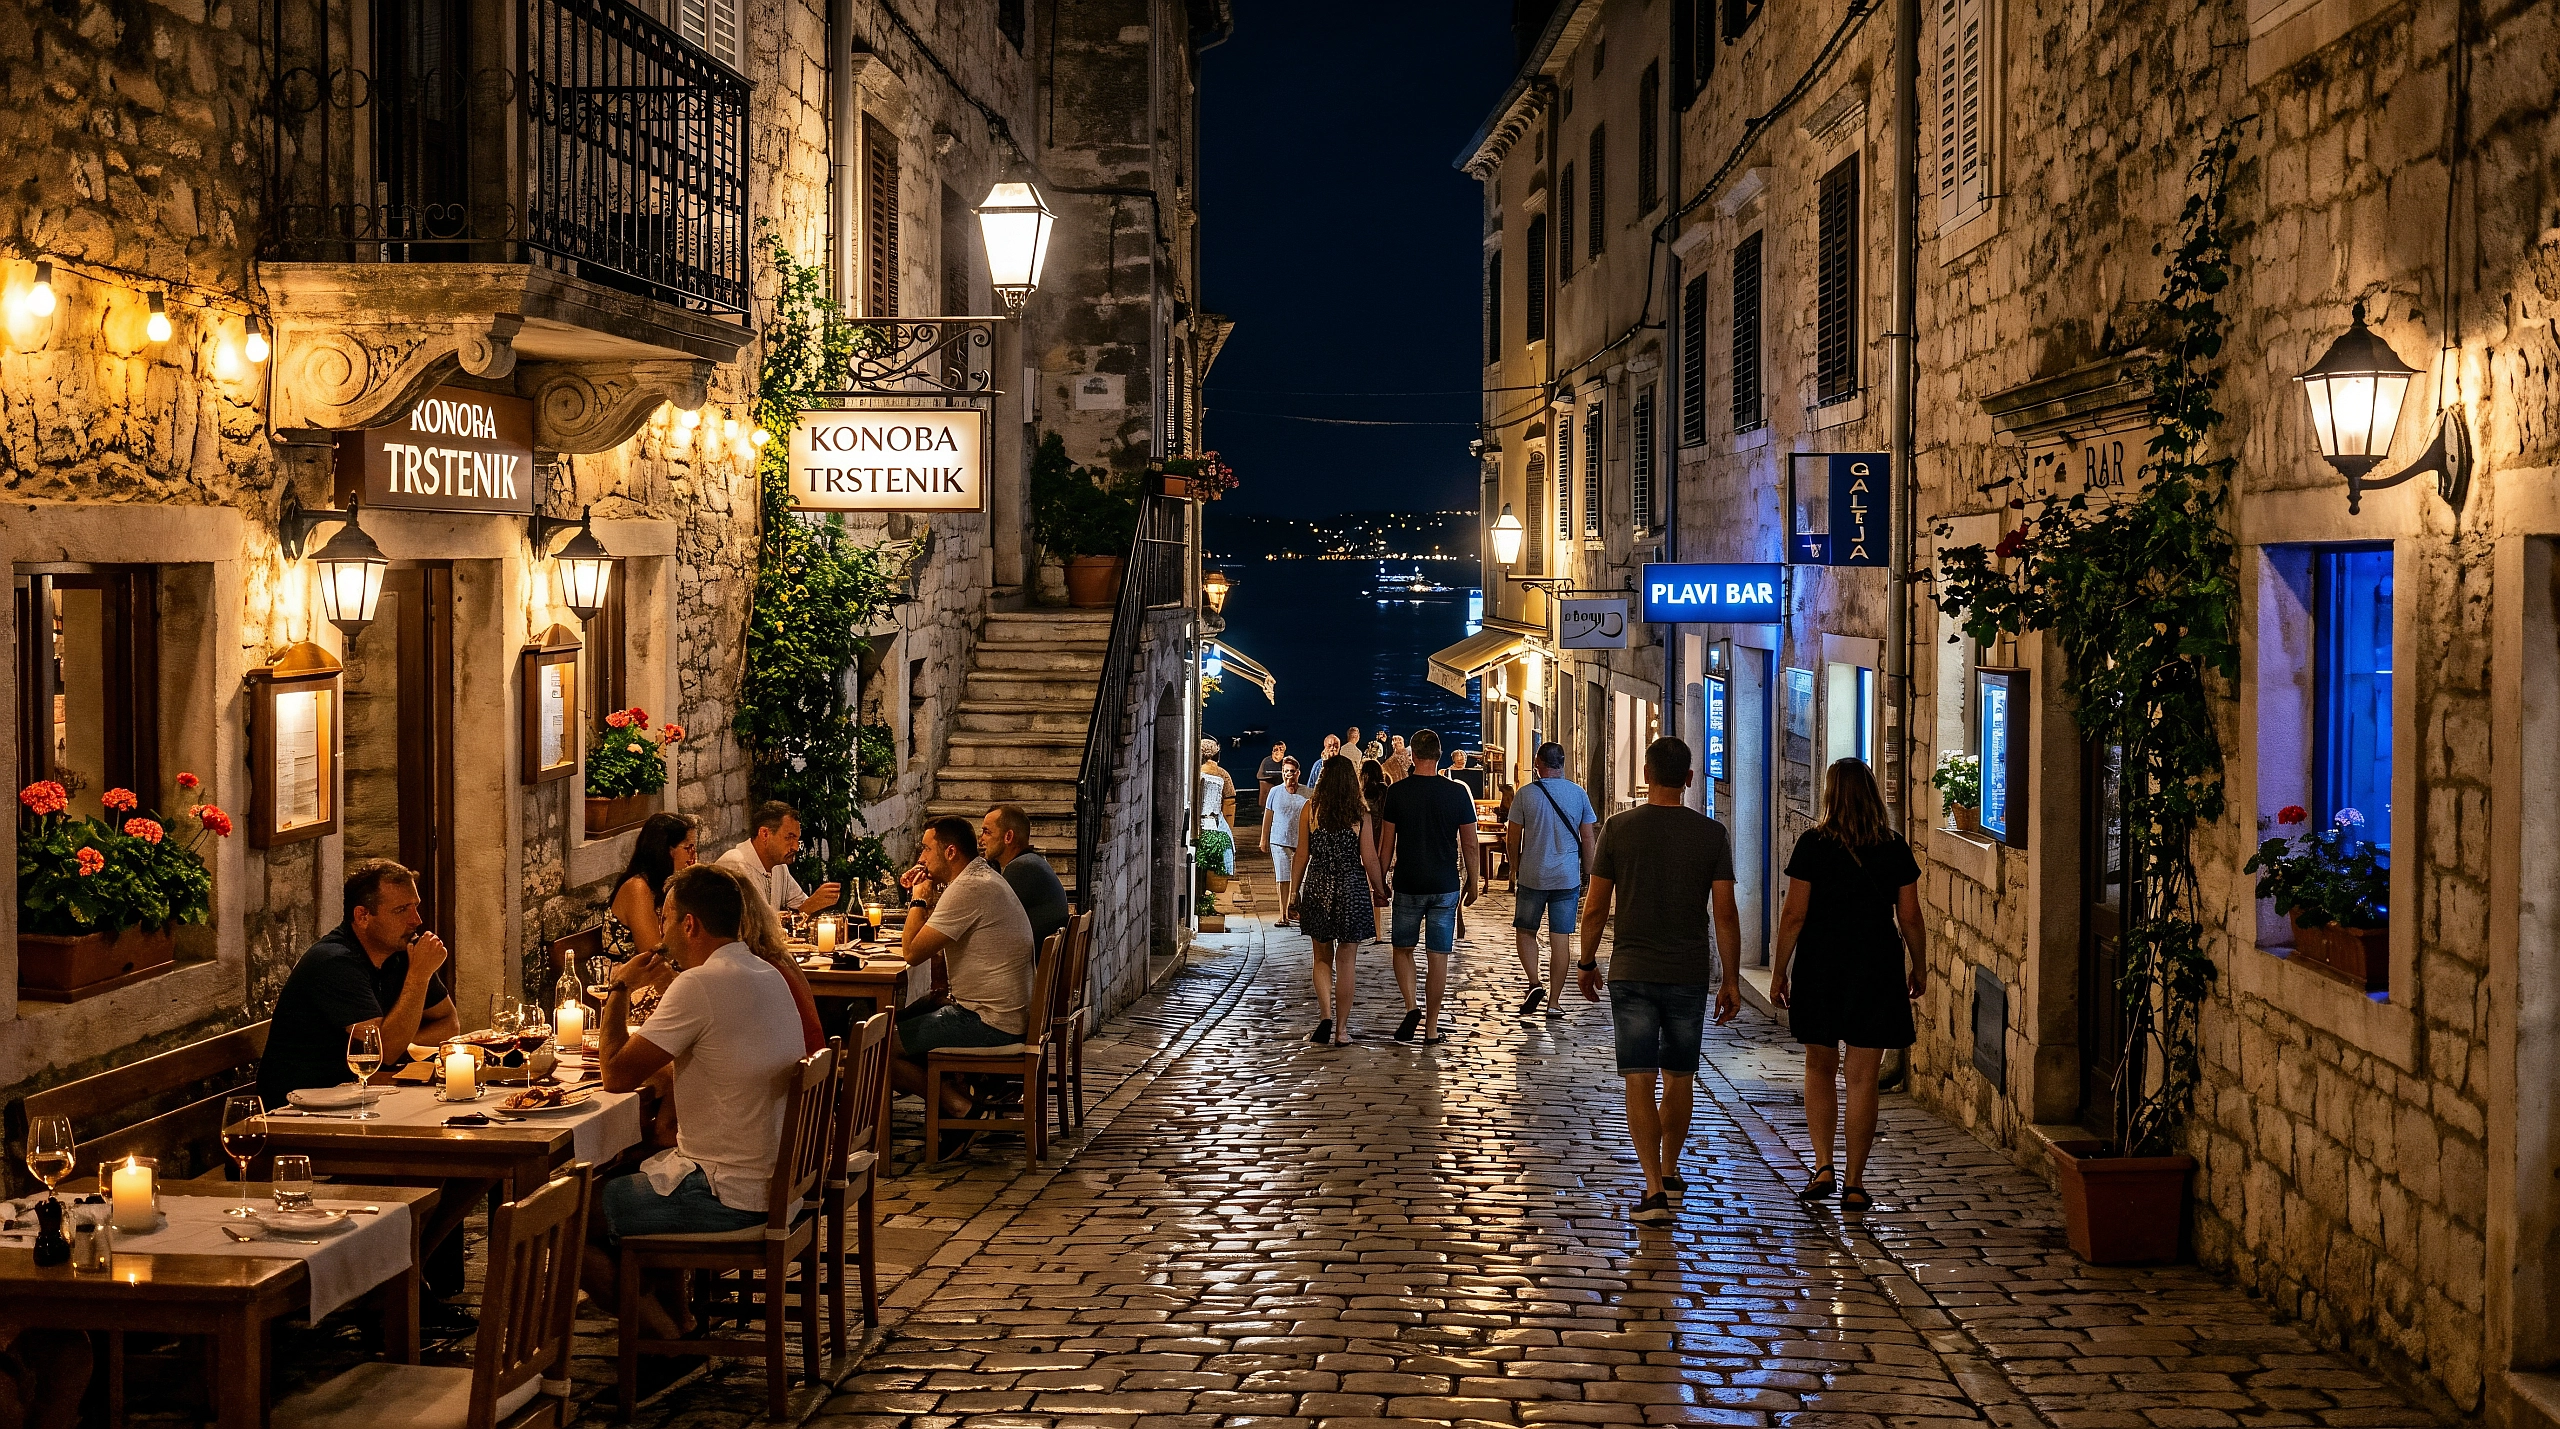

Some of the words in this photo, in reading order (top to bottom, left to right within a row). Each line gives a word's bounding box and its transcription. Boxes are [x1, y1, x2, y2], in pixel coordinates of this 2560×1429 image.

[811, 426, 958, 451] KONOBA
[383, 443, 518, 500] TRSTENIK
[804, 467, 965, 493] TRSTENIK
[1651, 583, 1717, 604] PLAVI
[1726, 582, 1773, 604] BAR
